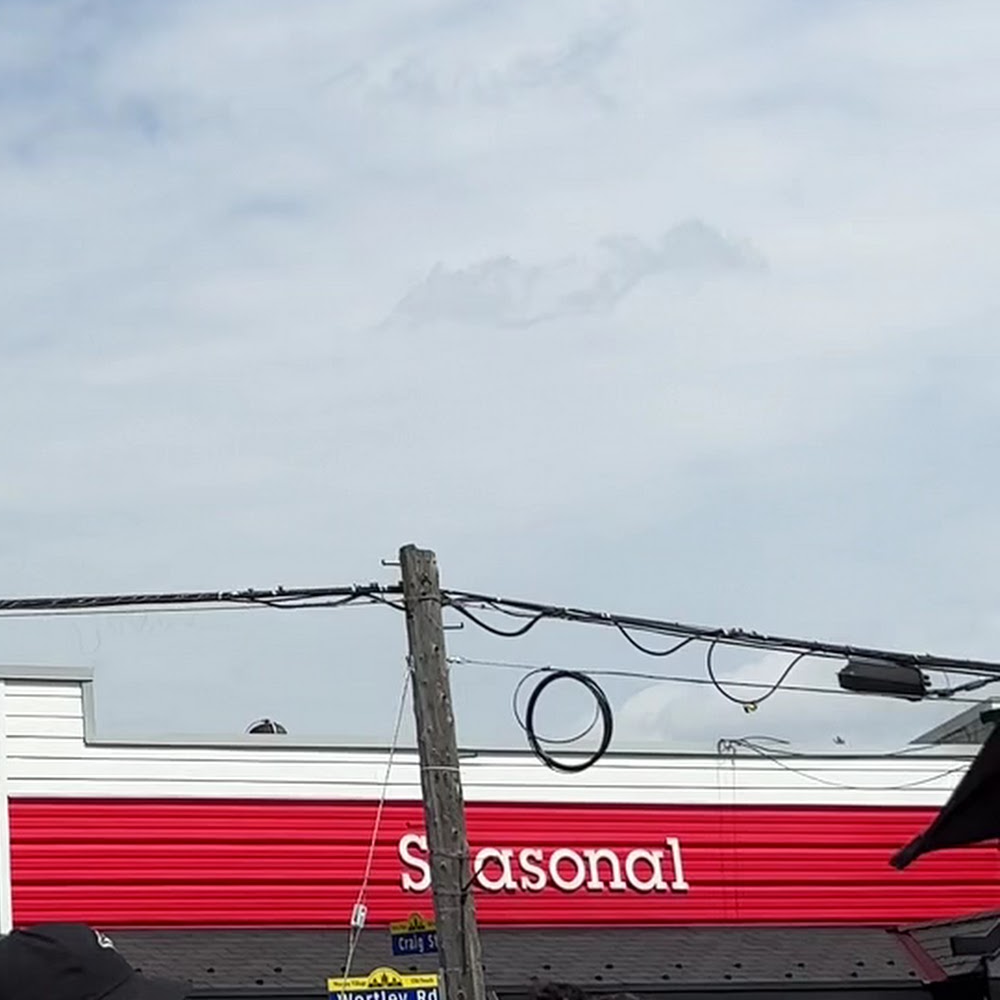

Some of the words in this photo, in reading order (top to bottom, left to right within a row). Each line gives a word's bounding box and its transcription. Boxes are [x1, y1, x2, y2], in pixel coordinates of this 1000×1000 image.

[399, 833, 689, 891] Sasonal
[398, 935, 424, 953] Craig
[416, 988, 438, 1000] Rd
